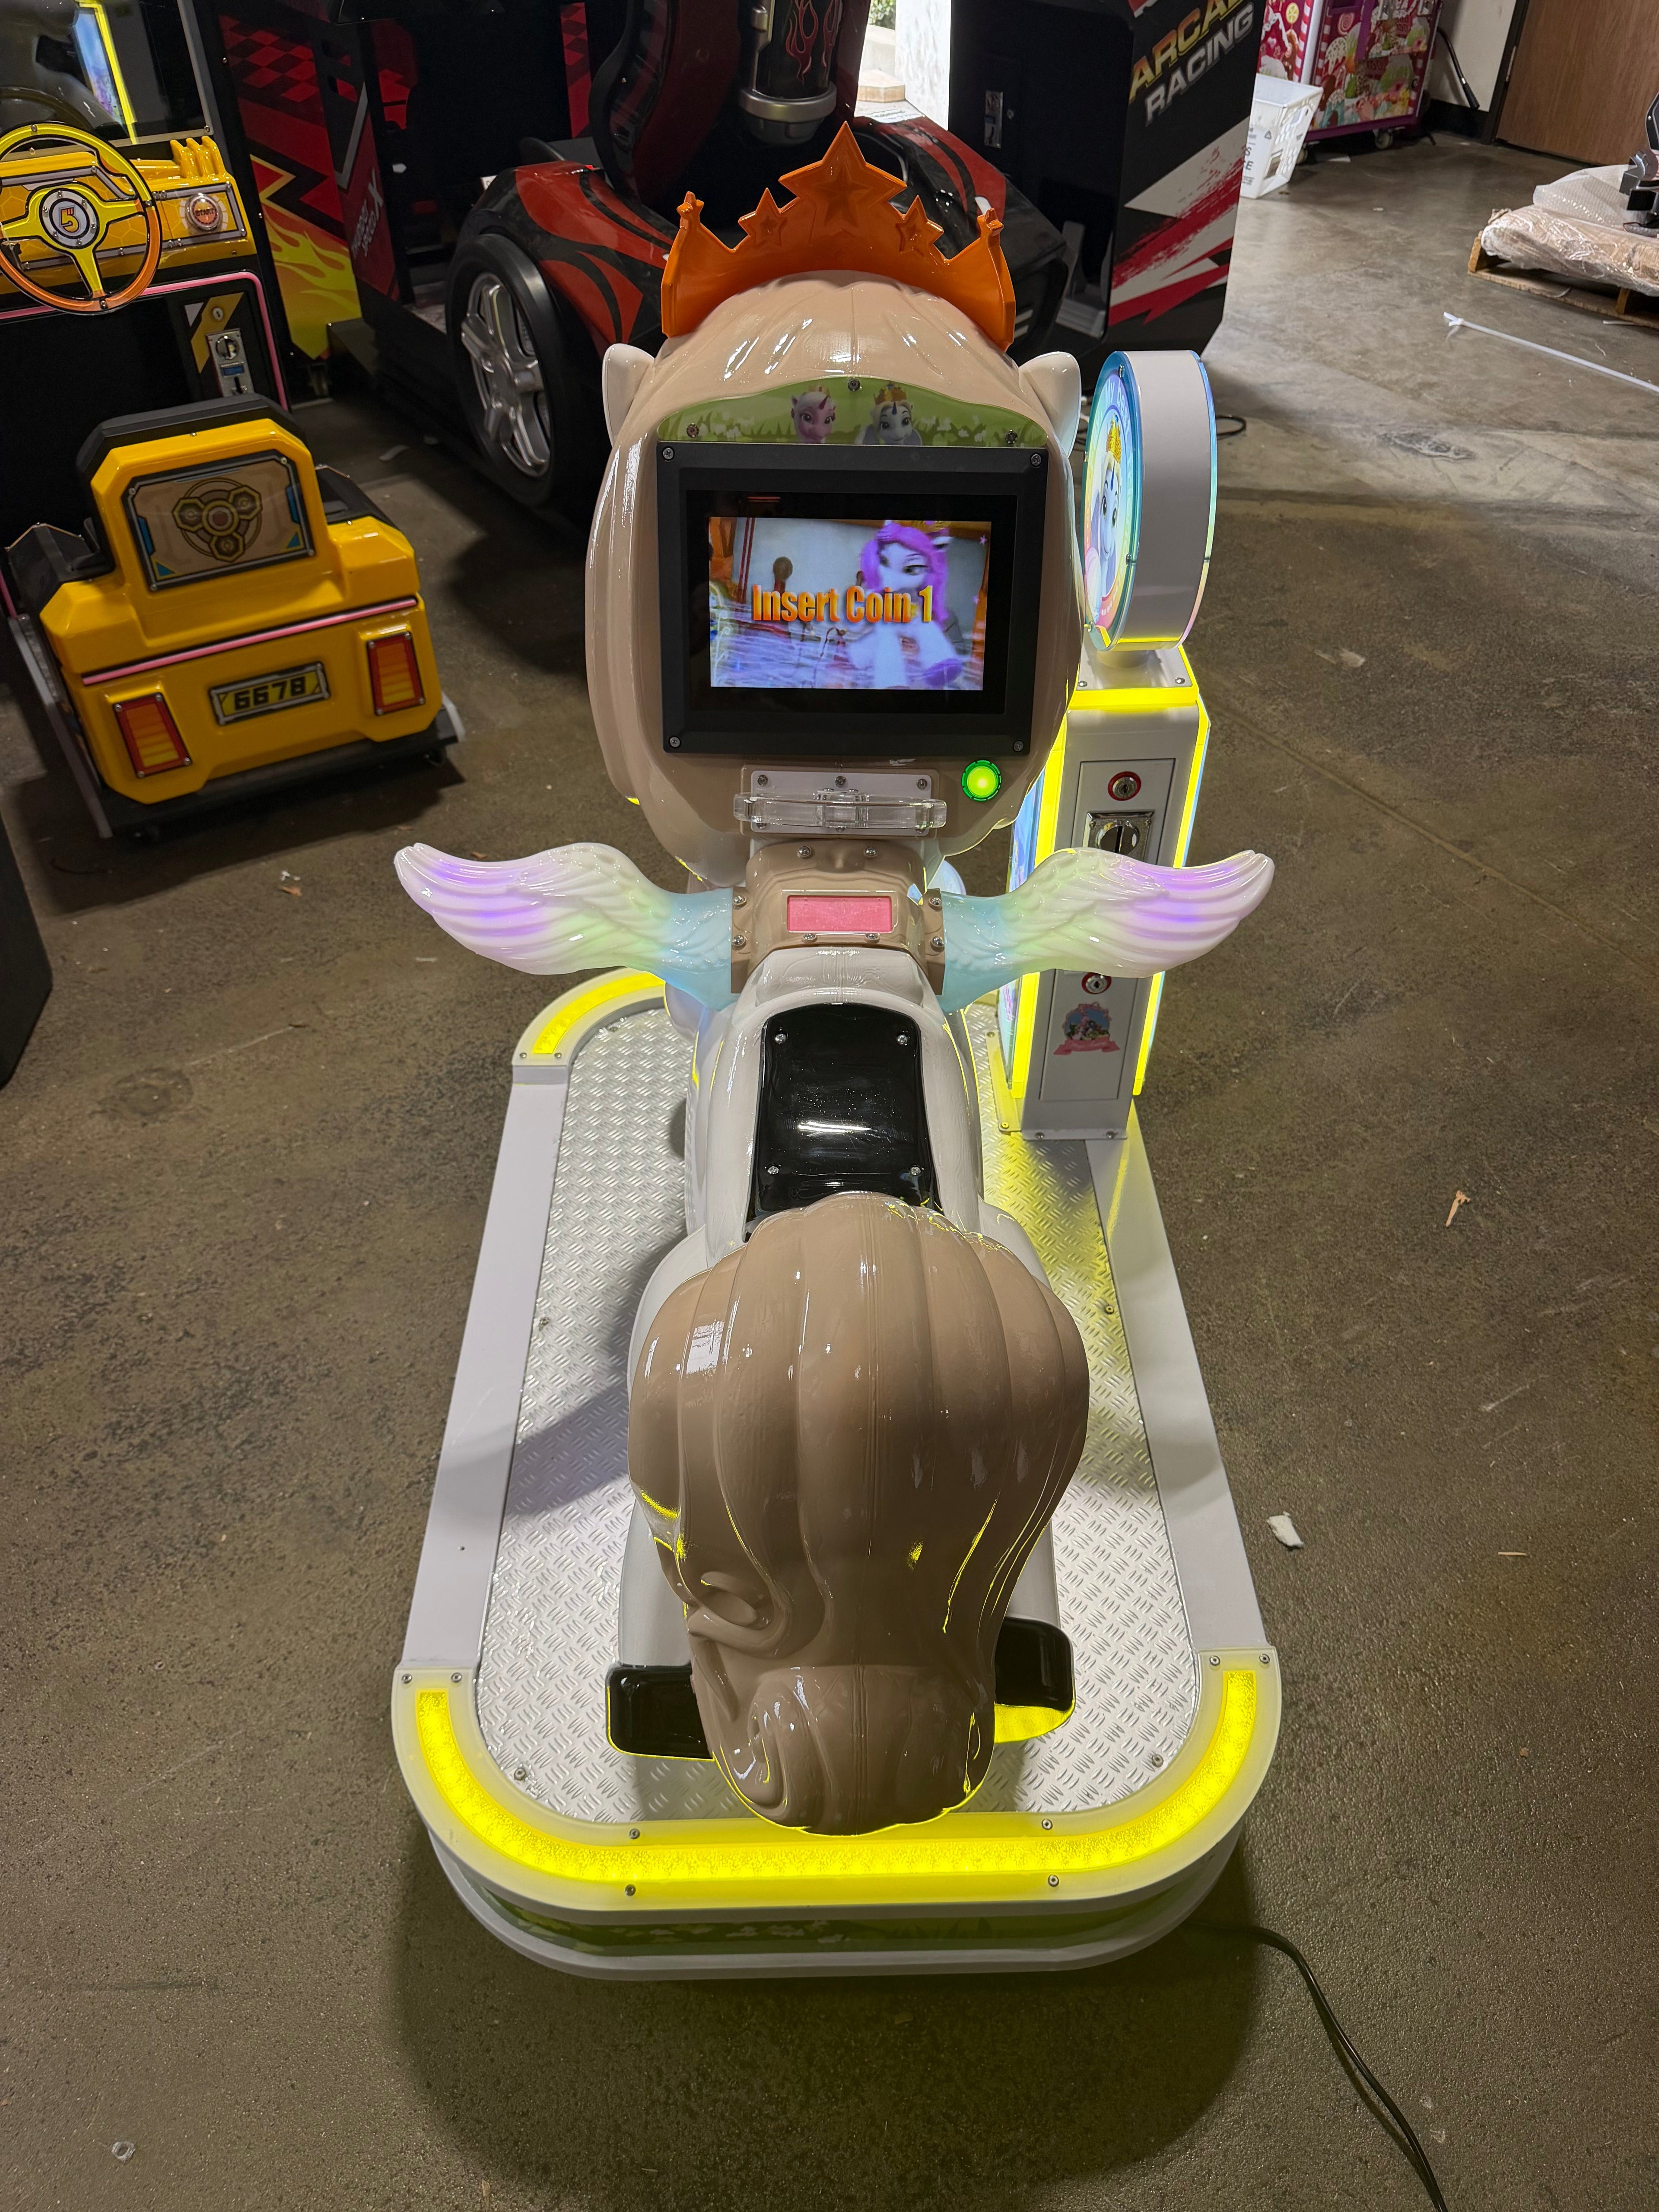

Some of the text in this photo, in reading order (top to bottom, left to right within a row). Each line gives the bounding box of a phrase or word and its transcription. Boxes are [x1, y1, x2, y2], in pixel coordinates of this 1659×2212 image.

[1145, 2, 1254, 127] RACING
[60, 207, 79, 233] 5
[1105, 378, 1115, 408] My
[753, 585, 933, 623] Insert Coin 1
[234, 676, 306, 710] 6678
